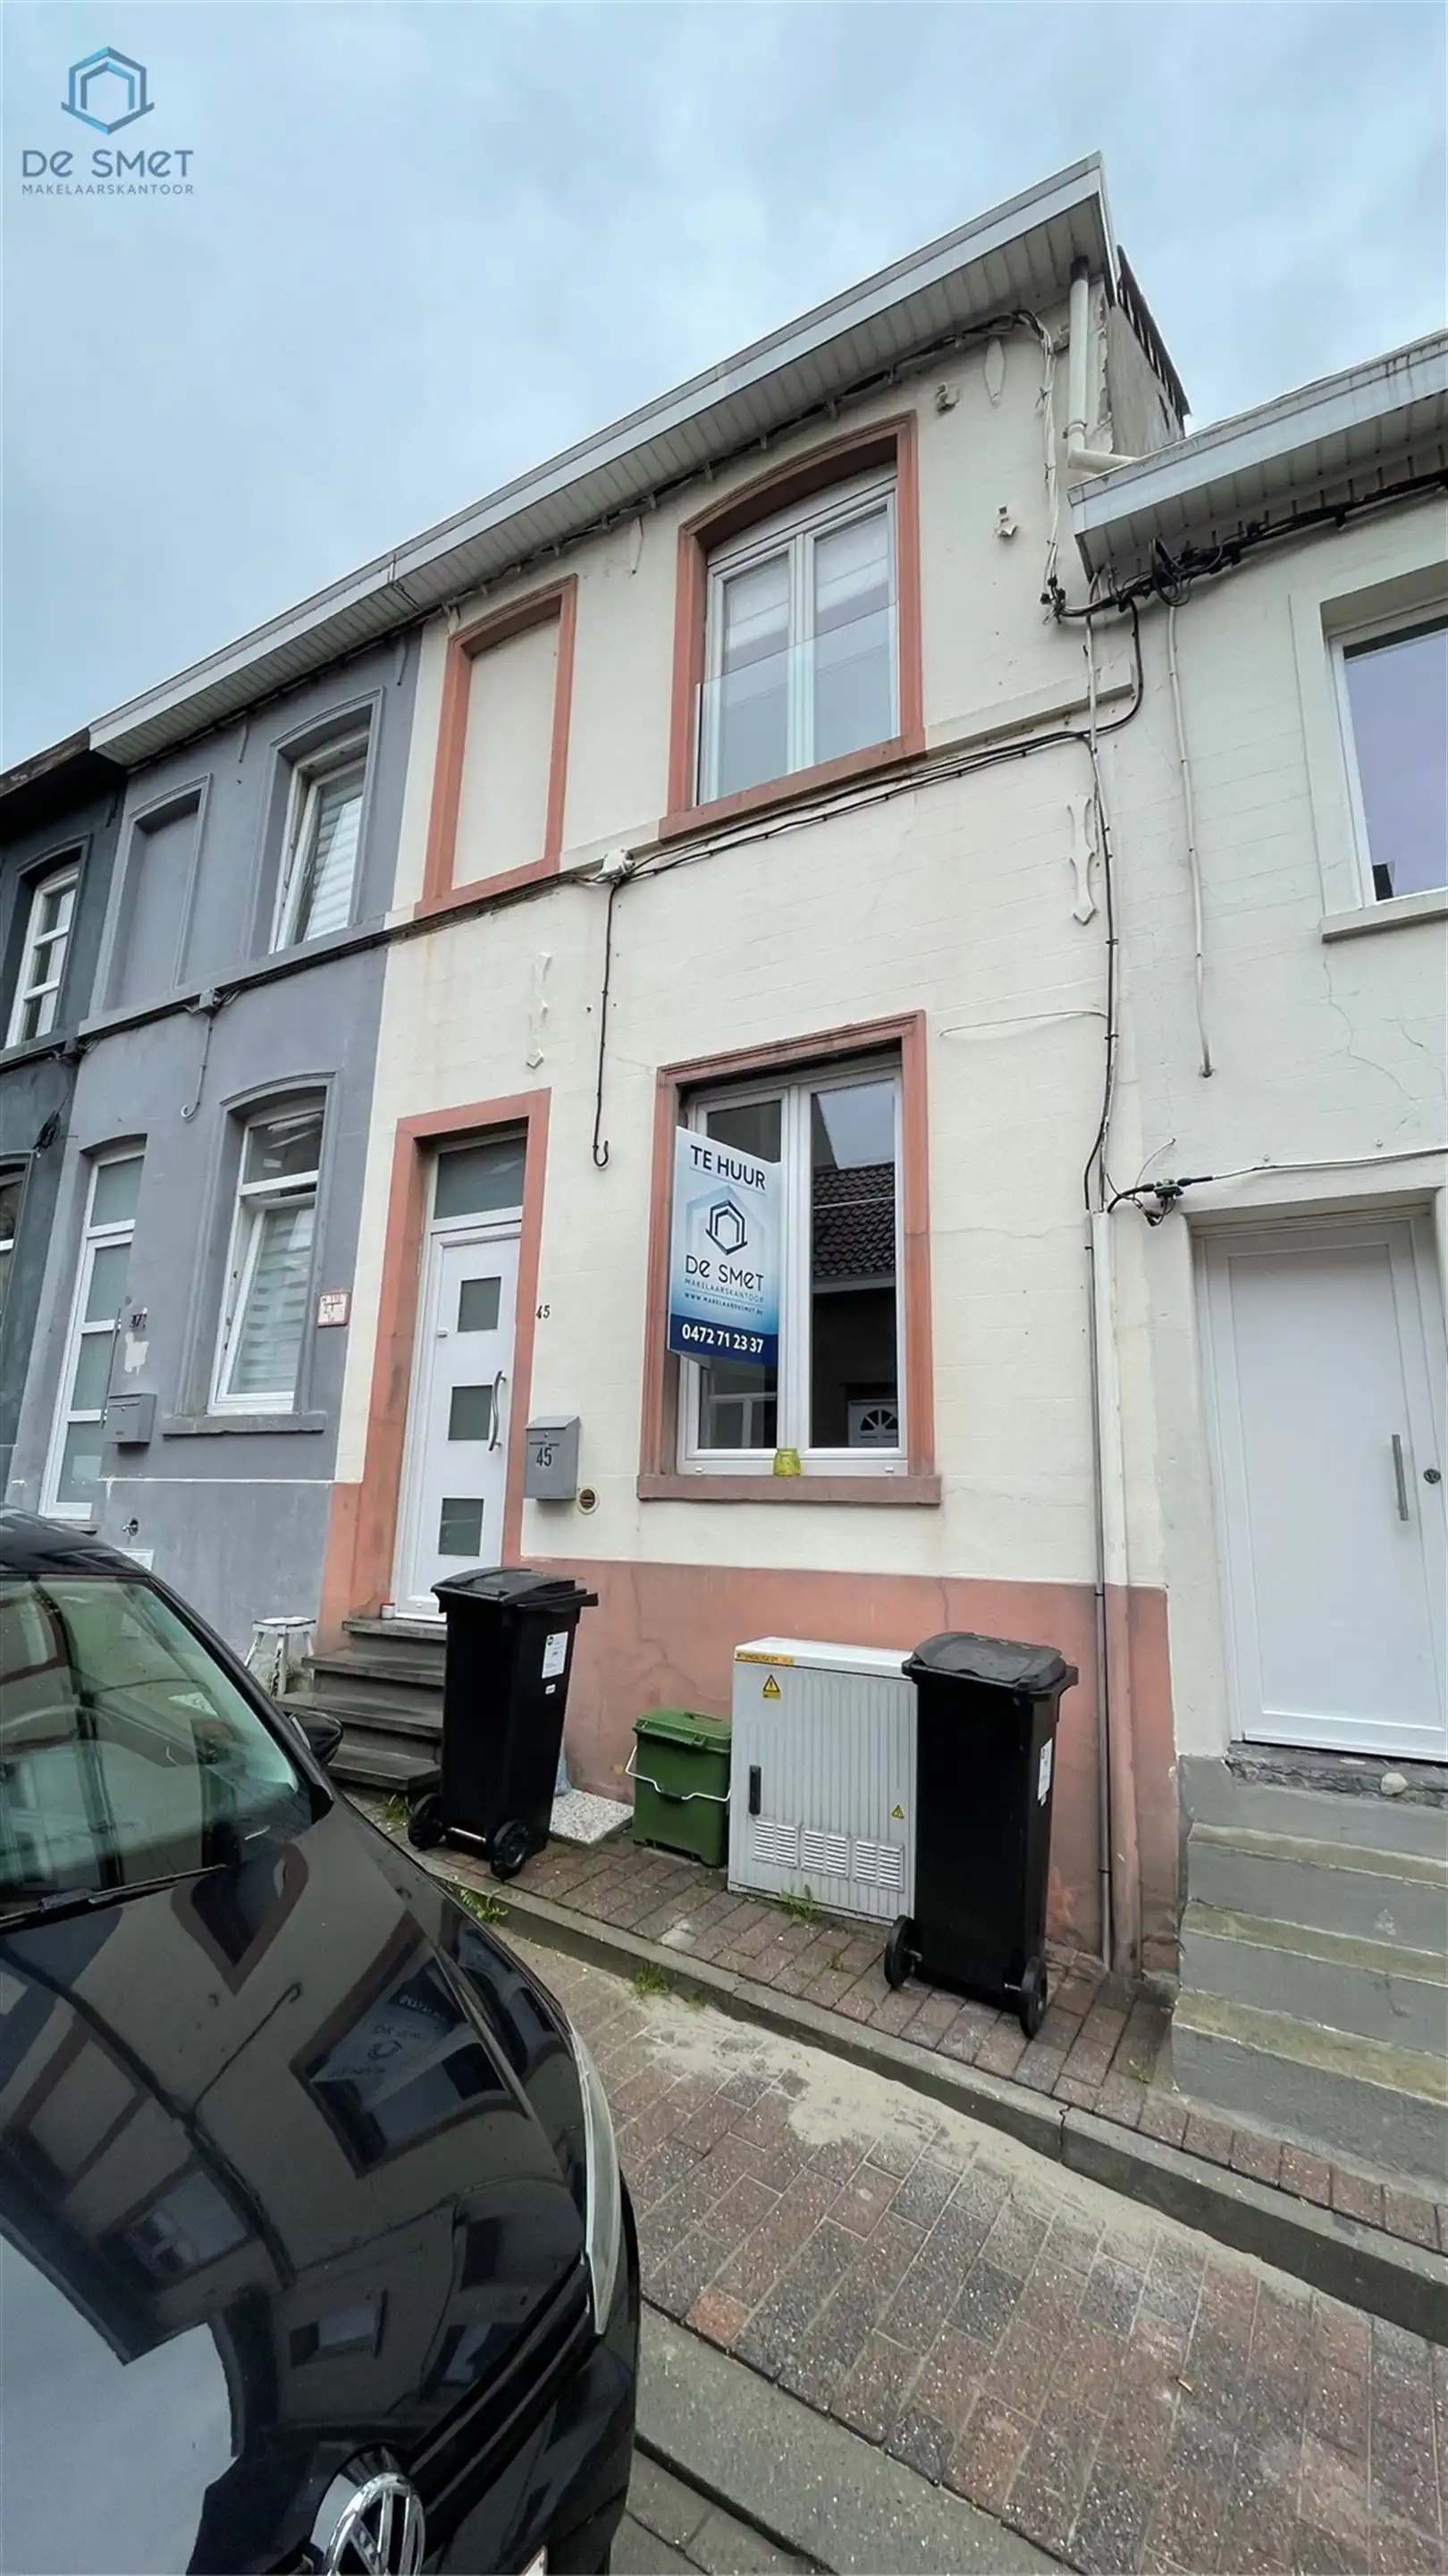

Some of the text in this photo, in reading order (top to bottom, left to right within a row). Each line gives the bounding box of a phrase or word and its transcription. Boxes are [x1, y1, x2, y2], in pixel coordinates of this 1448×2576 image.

[690, 1144, 766, 1191] TE HUUR
[535, 1304, 551, 1319] 45
[682, 1323, 764, 1354] 0472 71 23 37
[536, 1447, 552, 1467] 45
